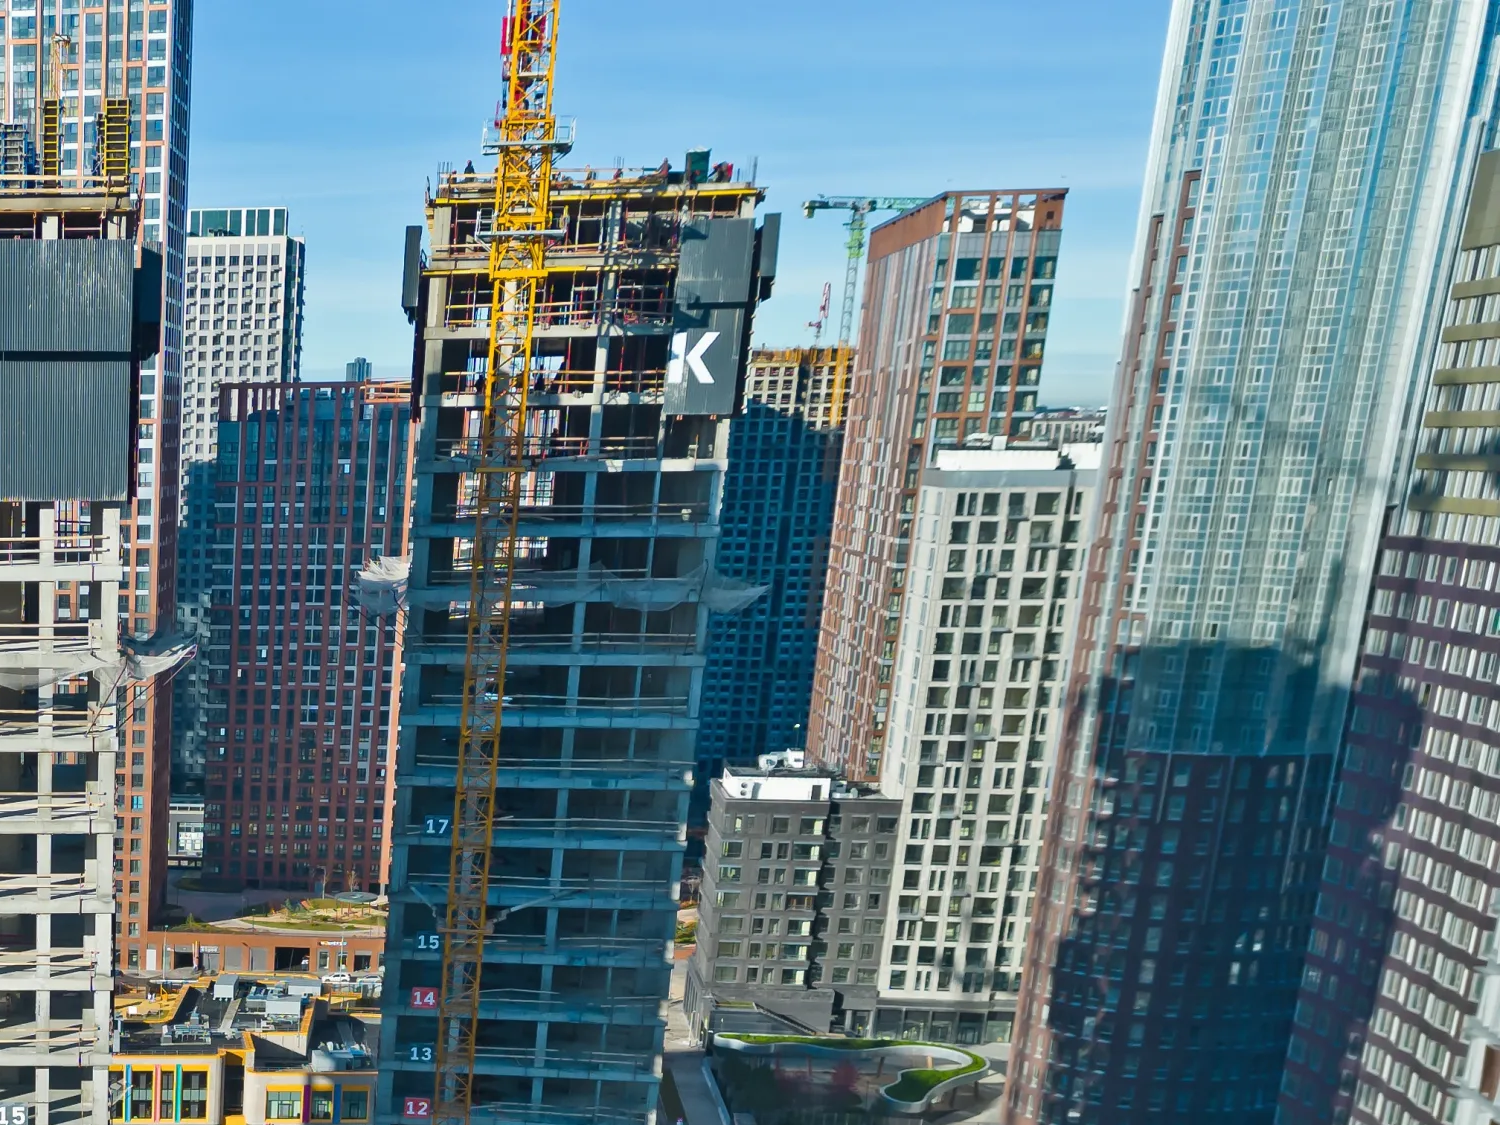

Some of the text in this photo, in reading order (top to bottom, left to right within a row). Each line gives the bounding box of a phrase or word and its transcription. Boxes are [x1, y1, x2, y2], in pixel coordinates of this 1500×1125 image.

[426, 819, 449, 834] 17
[417, 935, 440, 950] 15
[413, 991, 436, 1006] 14
[410, 1047, 432, 1061] 13
[406, 1101, 428, 1116] 12
